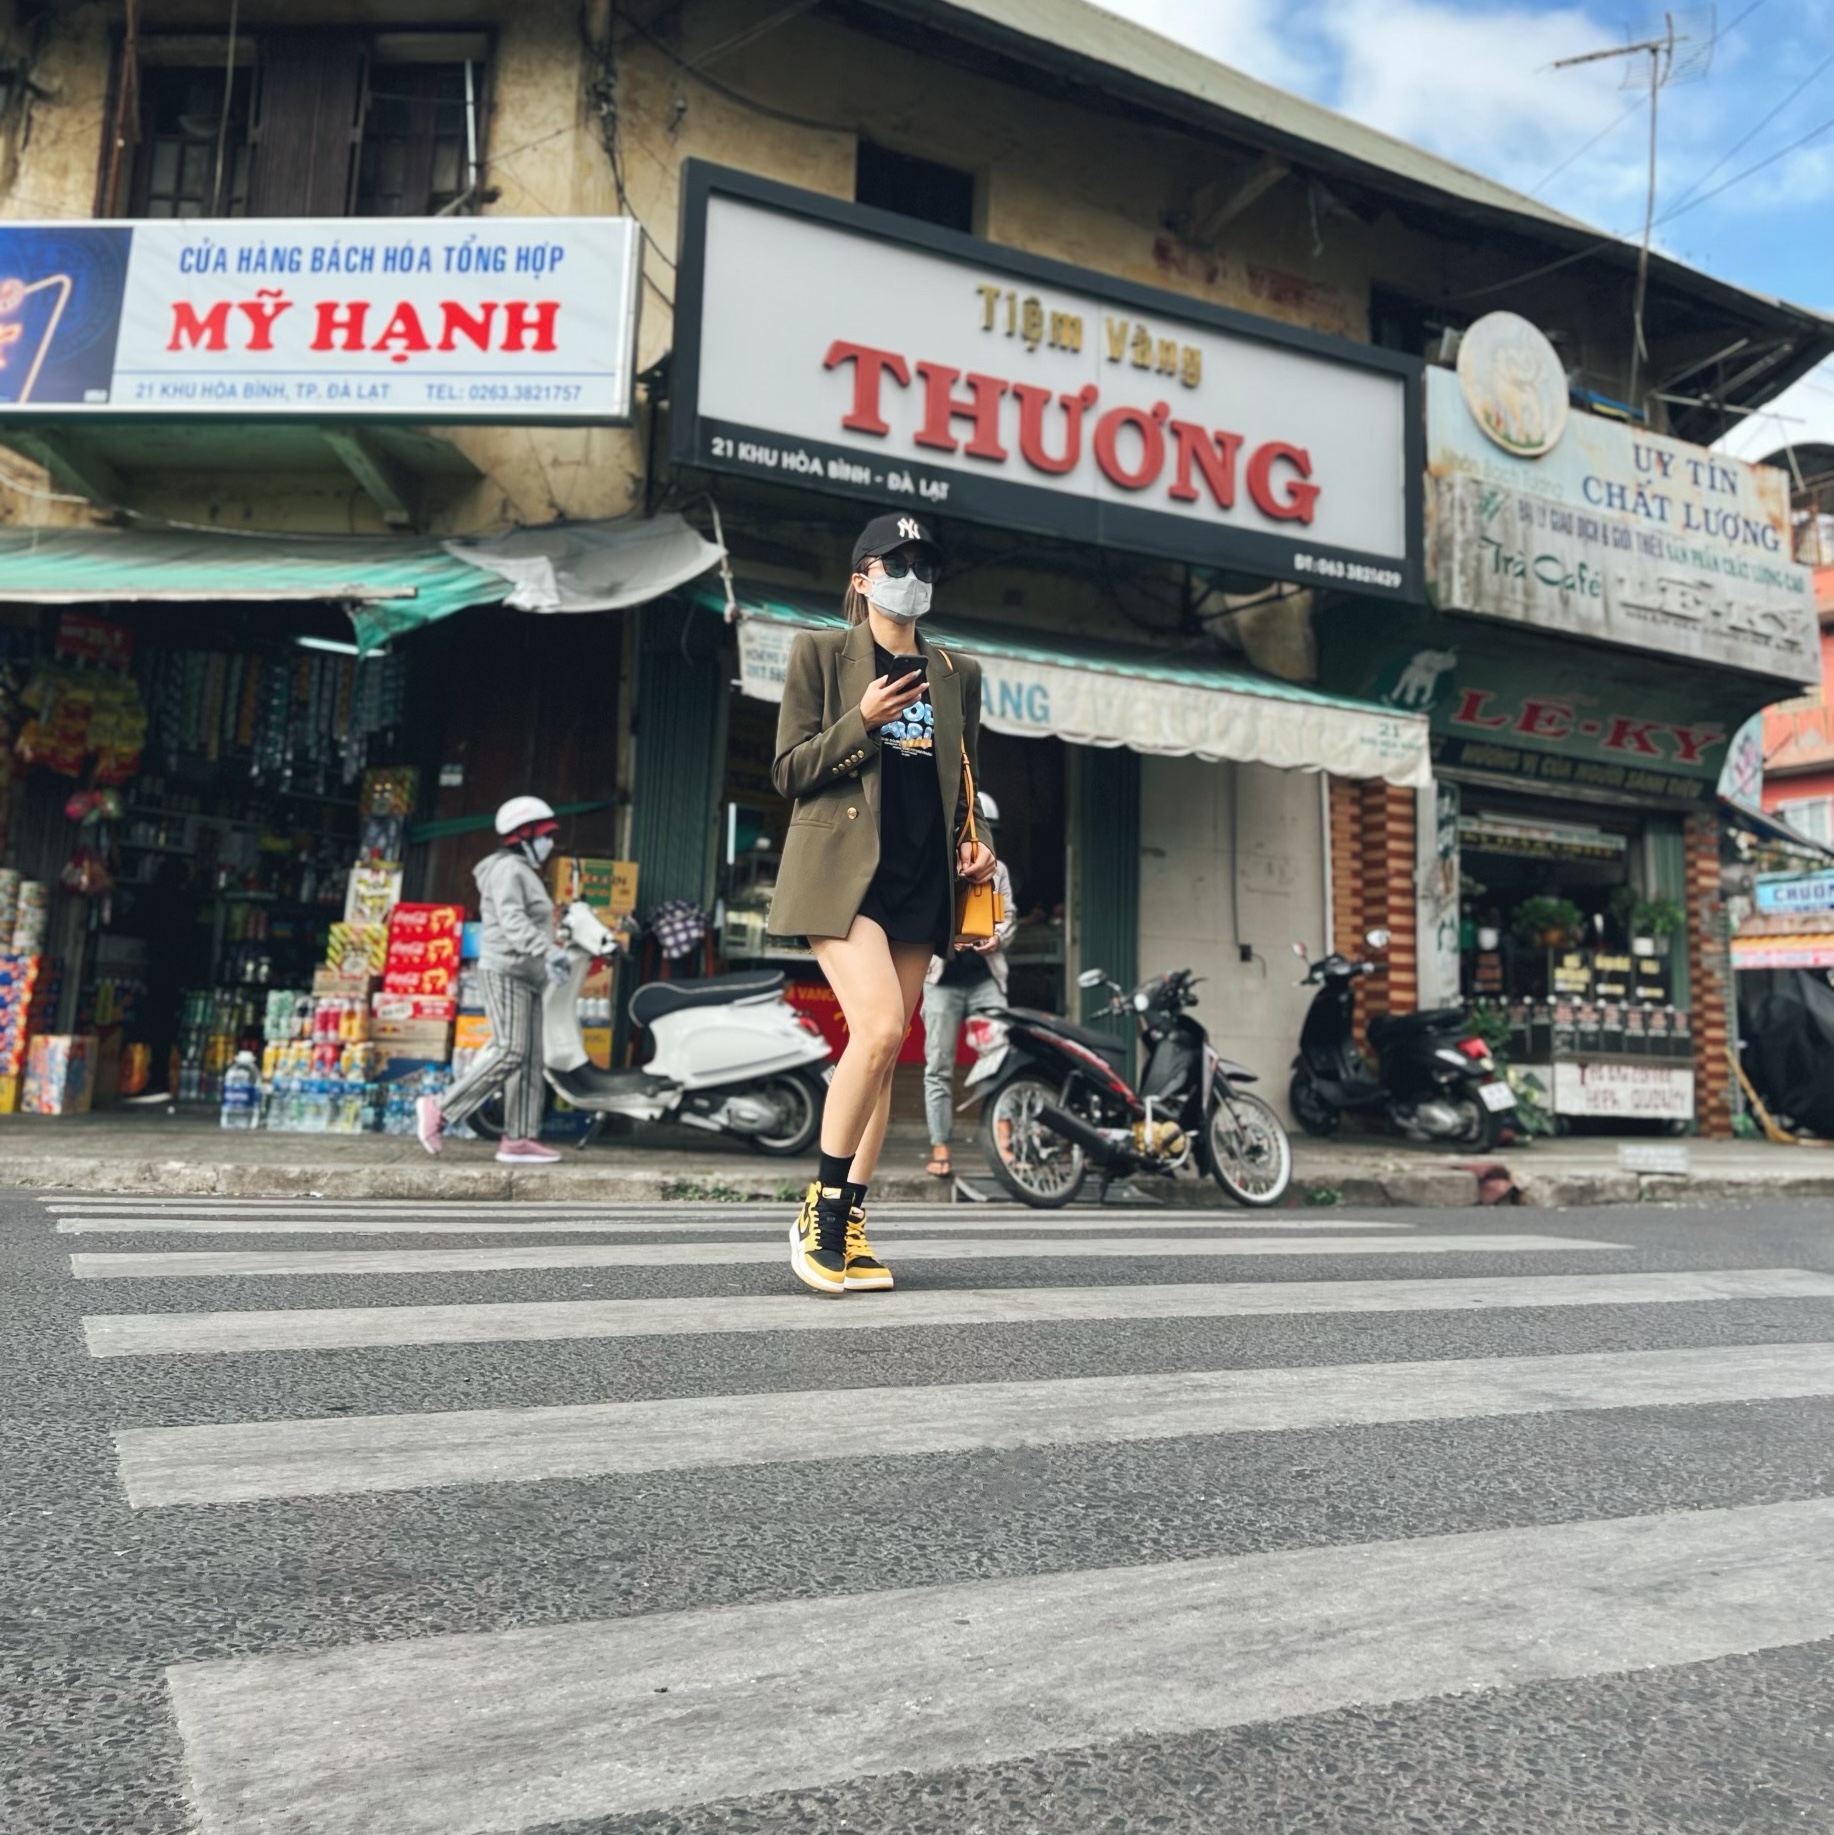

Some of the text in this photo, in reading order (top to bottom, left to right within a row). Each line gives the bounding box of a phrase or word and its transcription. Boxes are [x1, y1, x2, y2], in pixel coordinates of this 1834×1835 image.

[179, 233, 564, 280] CỬA HÀNG BÁCH HÓA TỔNG HỢP
[166, 288, 561, 363] MỸ HẠNH
[976, 282, 1202, 389] Tiệm Vàng
[136, 383, 154, 399] 21
[160, 384, 197, 398] KHU
[201, 382, 237, 399] HÒA
[327, 381, 351, 399] ĐÀ
[357, 384, 391, 403] LẠT
[427, 384, 464, 399] TEL:
[822, 340, 1321, 525] THƯƠNG
[711, 437, 734, 458] 21
[738, 441, 778, 467] KHU
[782, 448, 824, 477] HÒA
[828, 457, 871, 486] BÌNH
[887, 470, 915, 494] ĐÀ
[919, 477, 950, 502] LẠT
[1633, 443, 1738, 496] UY TÍN
[897, 517, 920, 540] NY
[1582, 475, 1780, 552] CHẤT LƯỢNG
